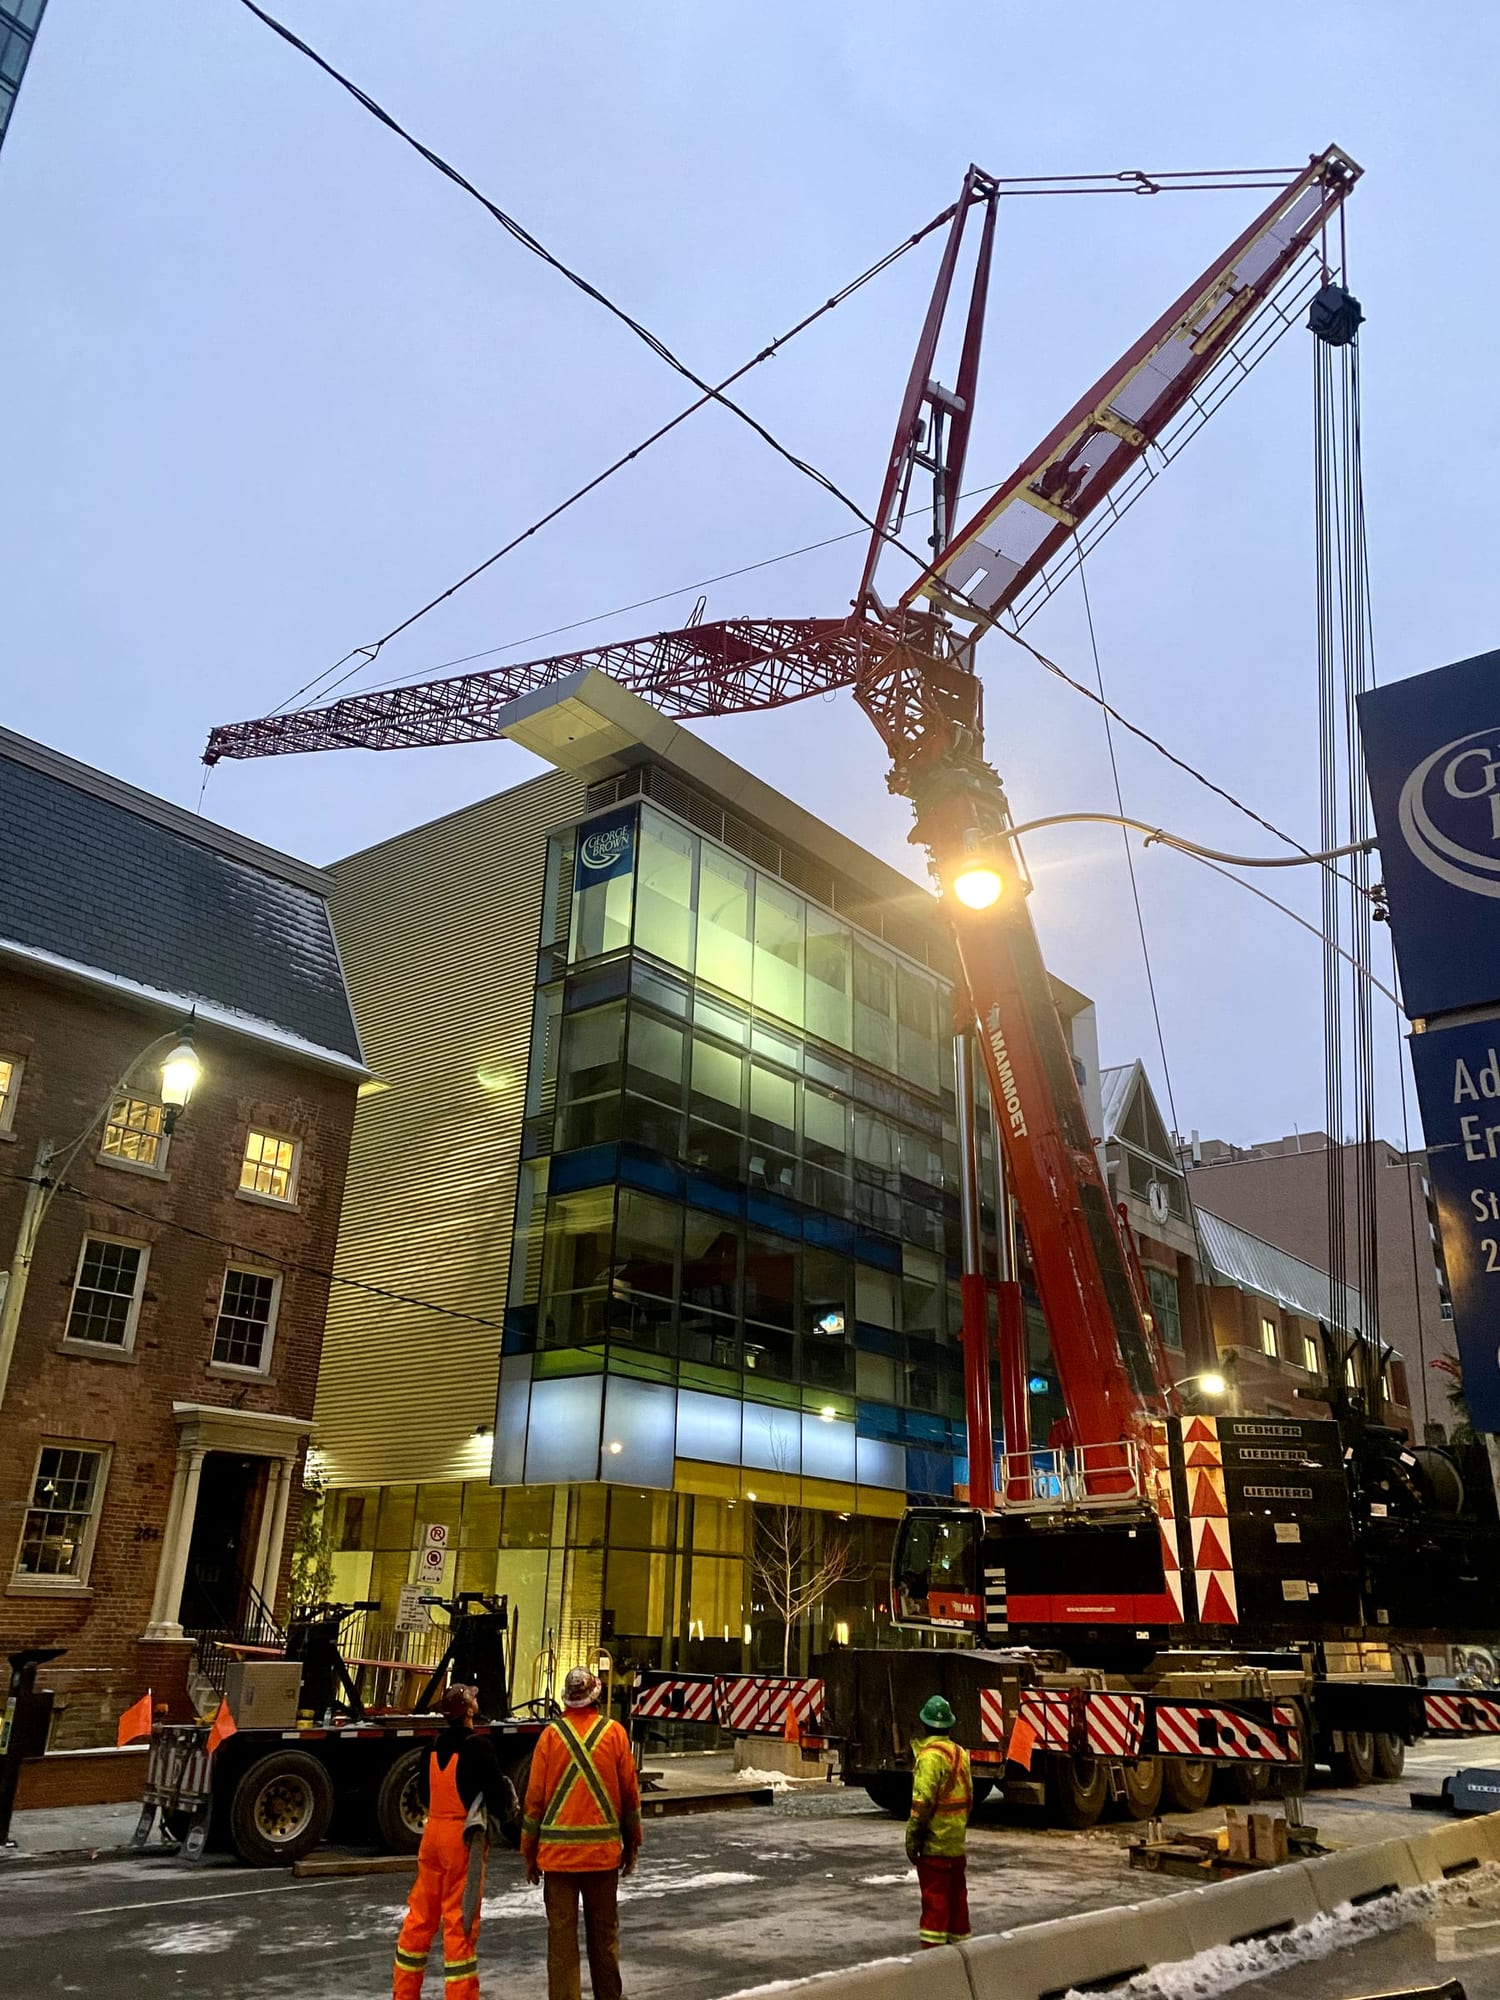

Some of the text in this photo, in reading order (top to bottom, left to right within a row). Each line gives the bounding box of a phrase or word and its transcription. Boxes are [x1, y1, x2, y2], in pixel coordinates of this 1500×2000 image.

[588, 825, 628, 848] GEORGE
[592, 833, 629, 856] BROWN
[990, 1030, 1028, 1138] MAMMOET
[1453, 1048, 1500, 1104] Ad
[1481, 1238, 1500, 1272] 2
[1234, 1425, 1301, 1436] LIEBHERR
[1240, 1449, 1307, 1460] LIEBHERR
[1244, 1486, 1312, 1498] LIEBHERR
